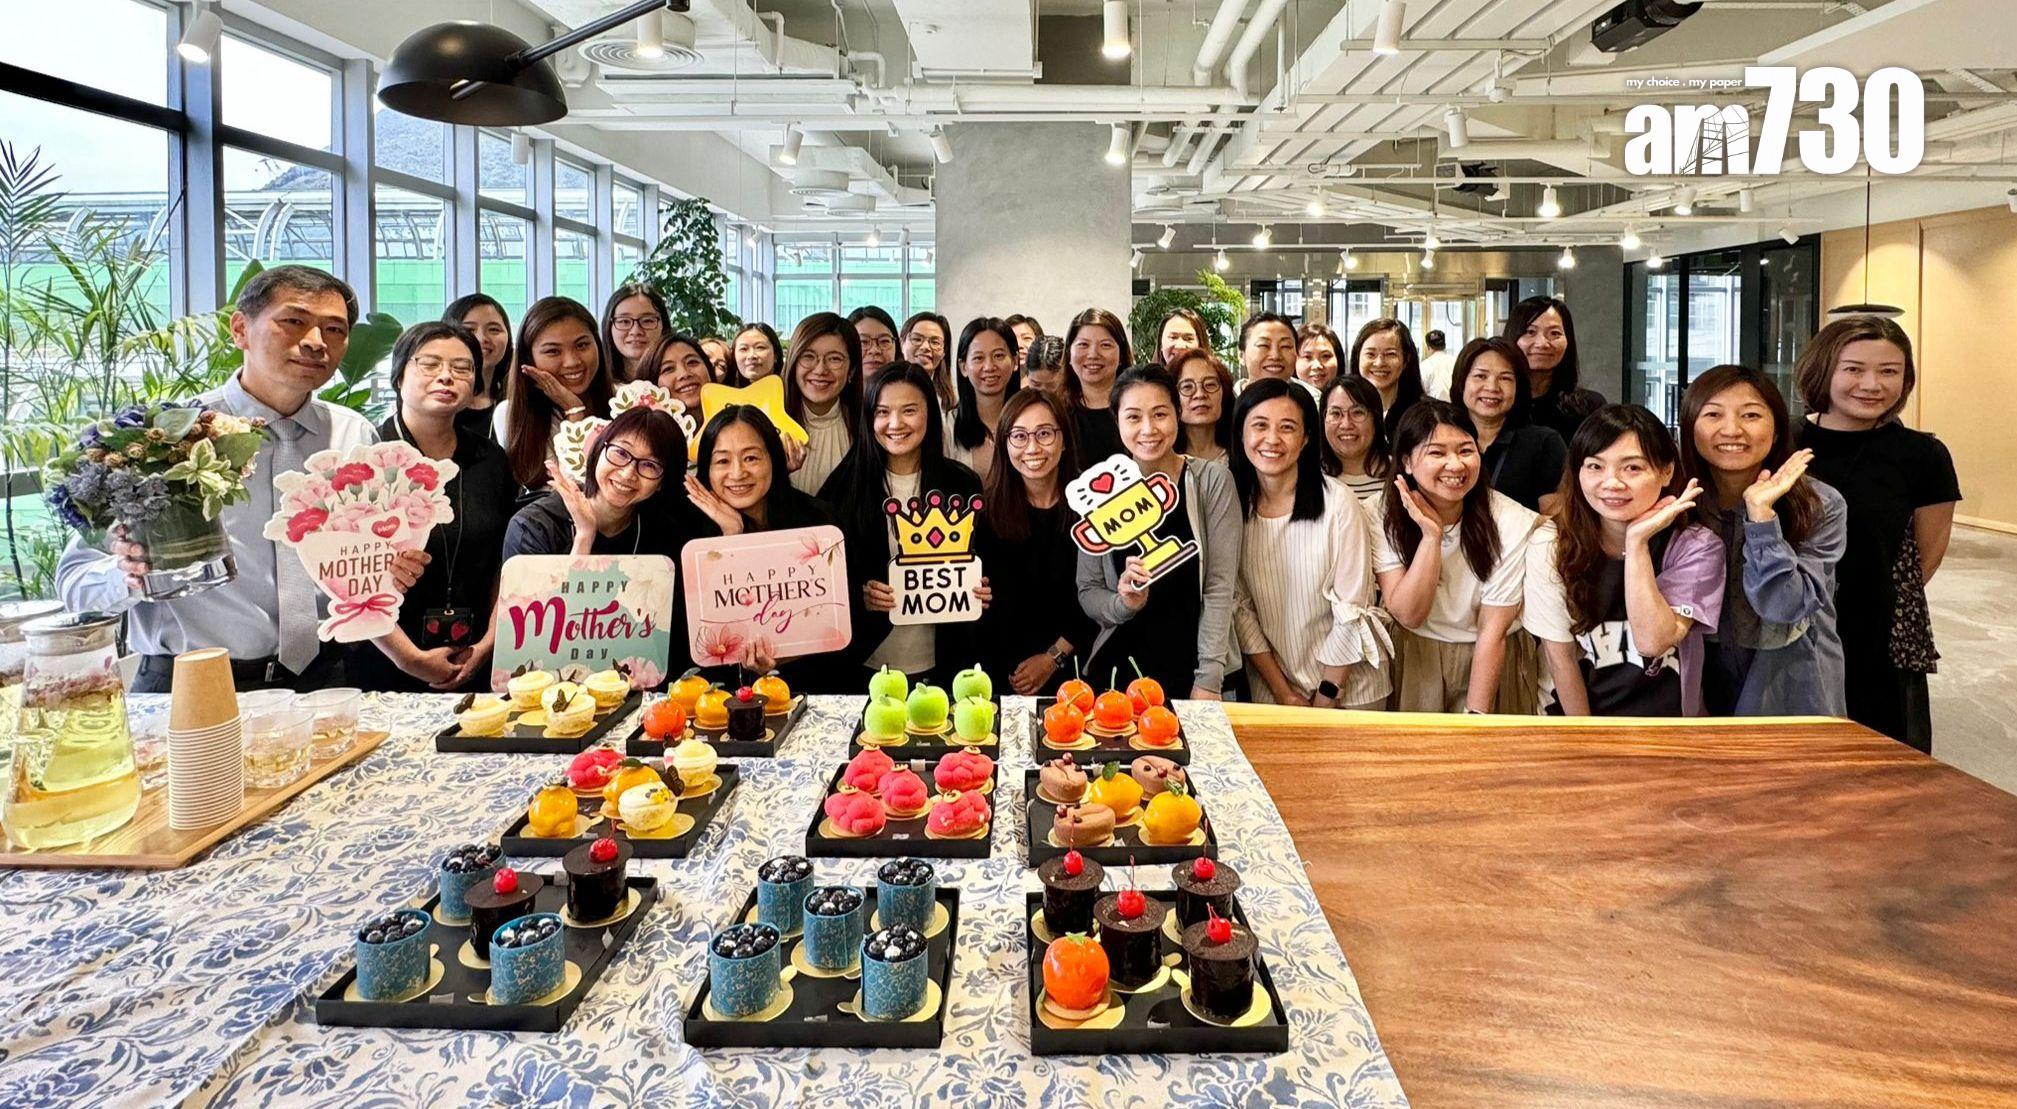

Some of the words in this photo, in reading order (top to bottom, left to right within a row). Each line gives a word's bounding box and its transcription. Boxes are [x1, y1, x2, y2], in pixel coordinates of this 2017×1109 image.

[1102, 496, 1154, 536] MOM
[340, 541, 392, 556] HAPPY
[348, 574, 383, 597] DAY
[723, 564, 818, 585] HAPPY
[904, 566, 967, 591] BEST
[561, 580, 629, 594] HAPPY
[714, 577, 827, 609] MOTHER'S
[901, 590, 970, 616] MOM
[509, 596, 657, 655] Mother's
[570, 647, 609, 661] Day
